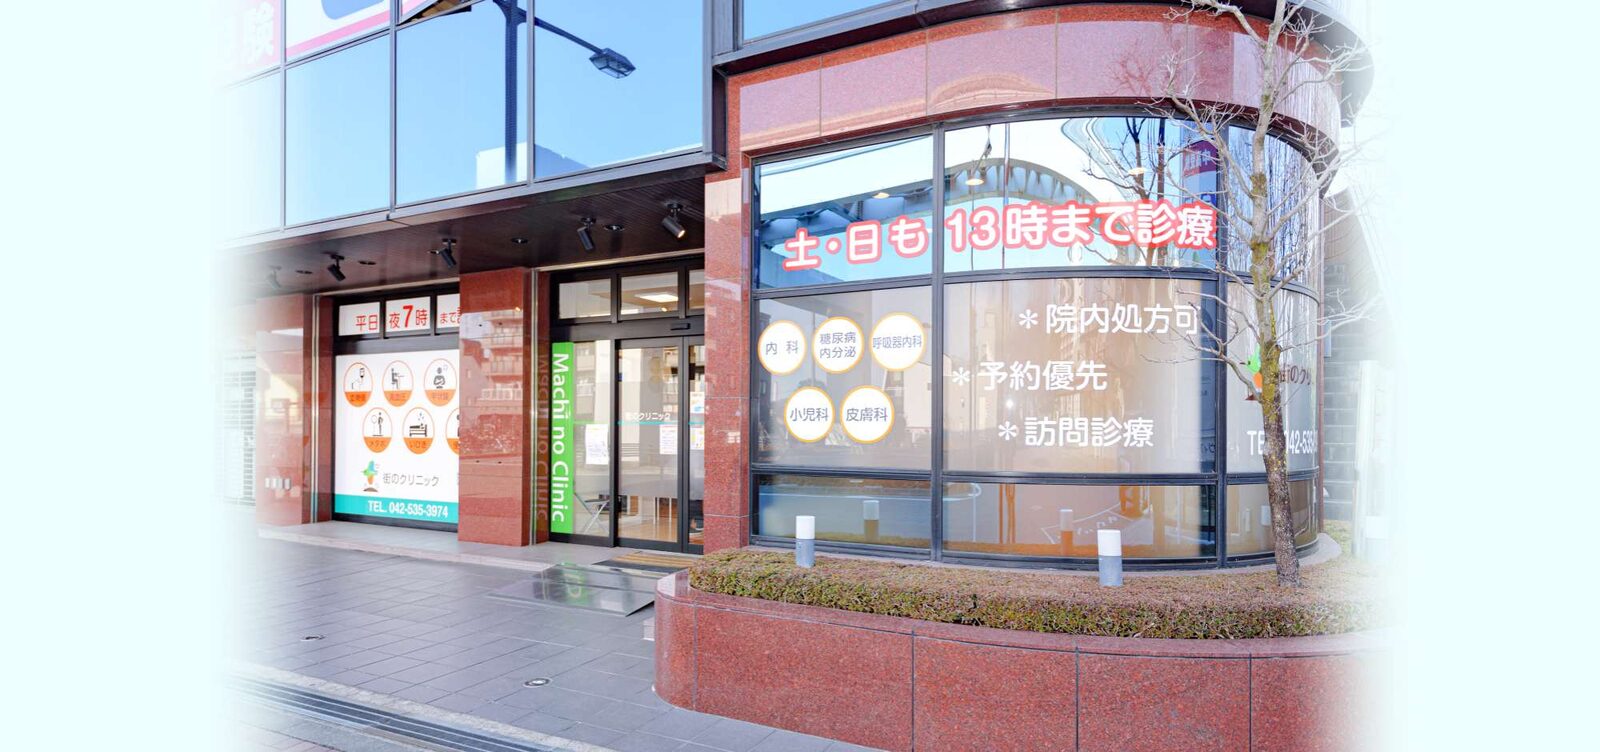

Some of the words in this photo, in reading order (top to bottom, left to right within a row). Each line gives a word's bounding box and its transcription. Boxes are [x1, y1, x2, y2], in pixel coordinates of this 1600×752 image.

[784, 222, 927, 270] 土・日も
[945, 201, 1217, 250] 13時まで診療
[355, 314, 378, 331] 平日
[389, 305, 428, 330] 夜7時
[1046, 304, 1201, 335] 院内処方可
[819, 331, 857, 345] 糖尿病
[872, 335, 922, 350] 呼吸器内科
[819, 346, 857, 359] 内分泌
[552, 353, 570, 419] Machi
[977, 360, 1108, 392] 予約優先
[789, 408, 829, 422] 小児科
[845, 407, 889, 422] 皮膚科
[552, 426, 567, 455] no
[1024, 416, 1154, 448] 訪問診療
[1246, 430, 1265, 456] TE
[383, 472, 440, 487] 街のクリニック
[552, 460, 569, 523] Clinic
[389, 502, 449, 519] 042-535-3974
